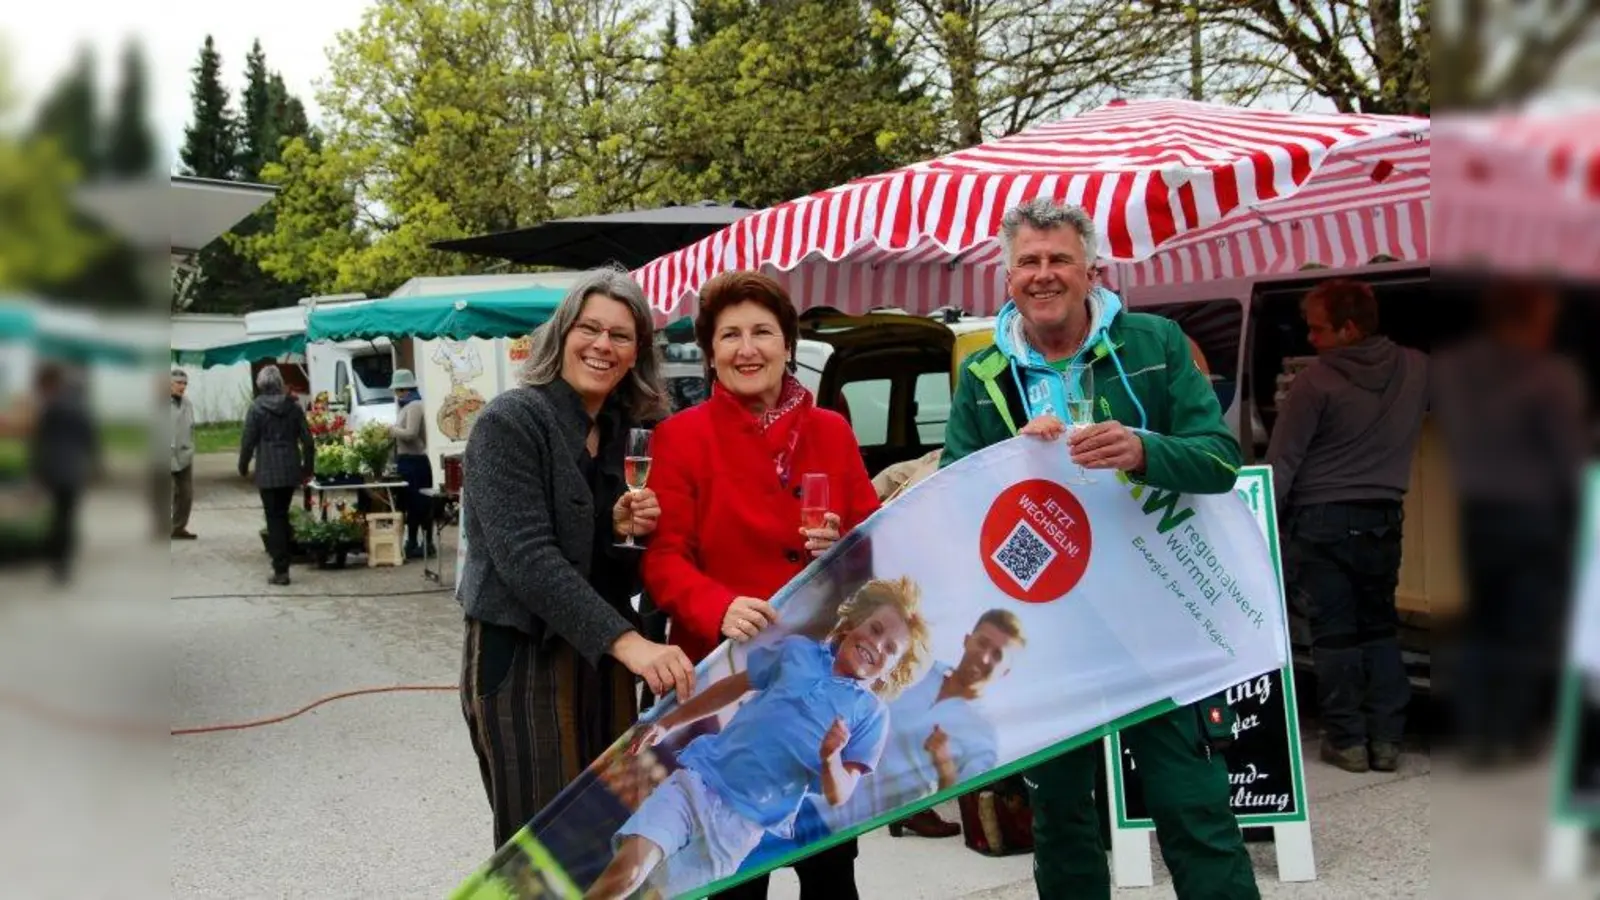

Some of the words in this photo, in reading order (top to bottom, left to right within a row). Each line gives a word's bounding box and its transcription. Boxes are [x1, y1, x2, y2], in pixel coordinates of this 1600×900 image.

[1019, 494, 1080, 557] WECHSELN!
[1042, 498, 1075, 529] JETZT
[1132, 536, 1168, 579] Energie
[1185, 601, 1202, 620] die
[1202, 619, 1236, 656] Region
[1166, 533, 1221, 606] würmtal
[1184, 524, 1263, 629] regionalwerk
